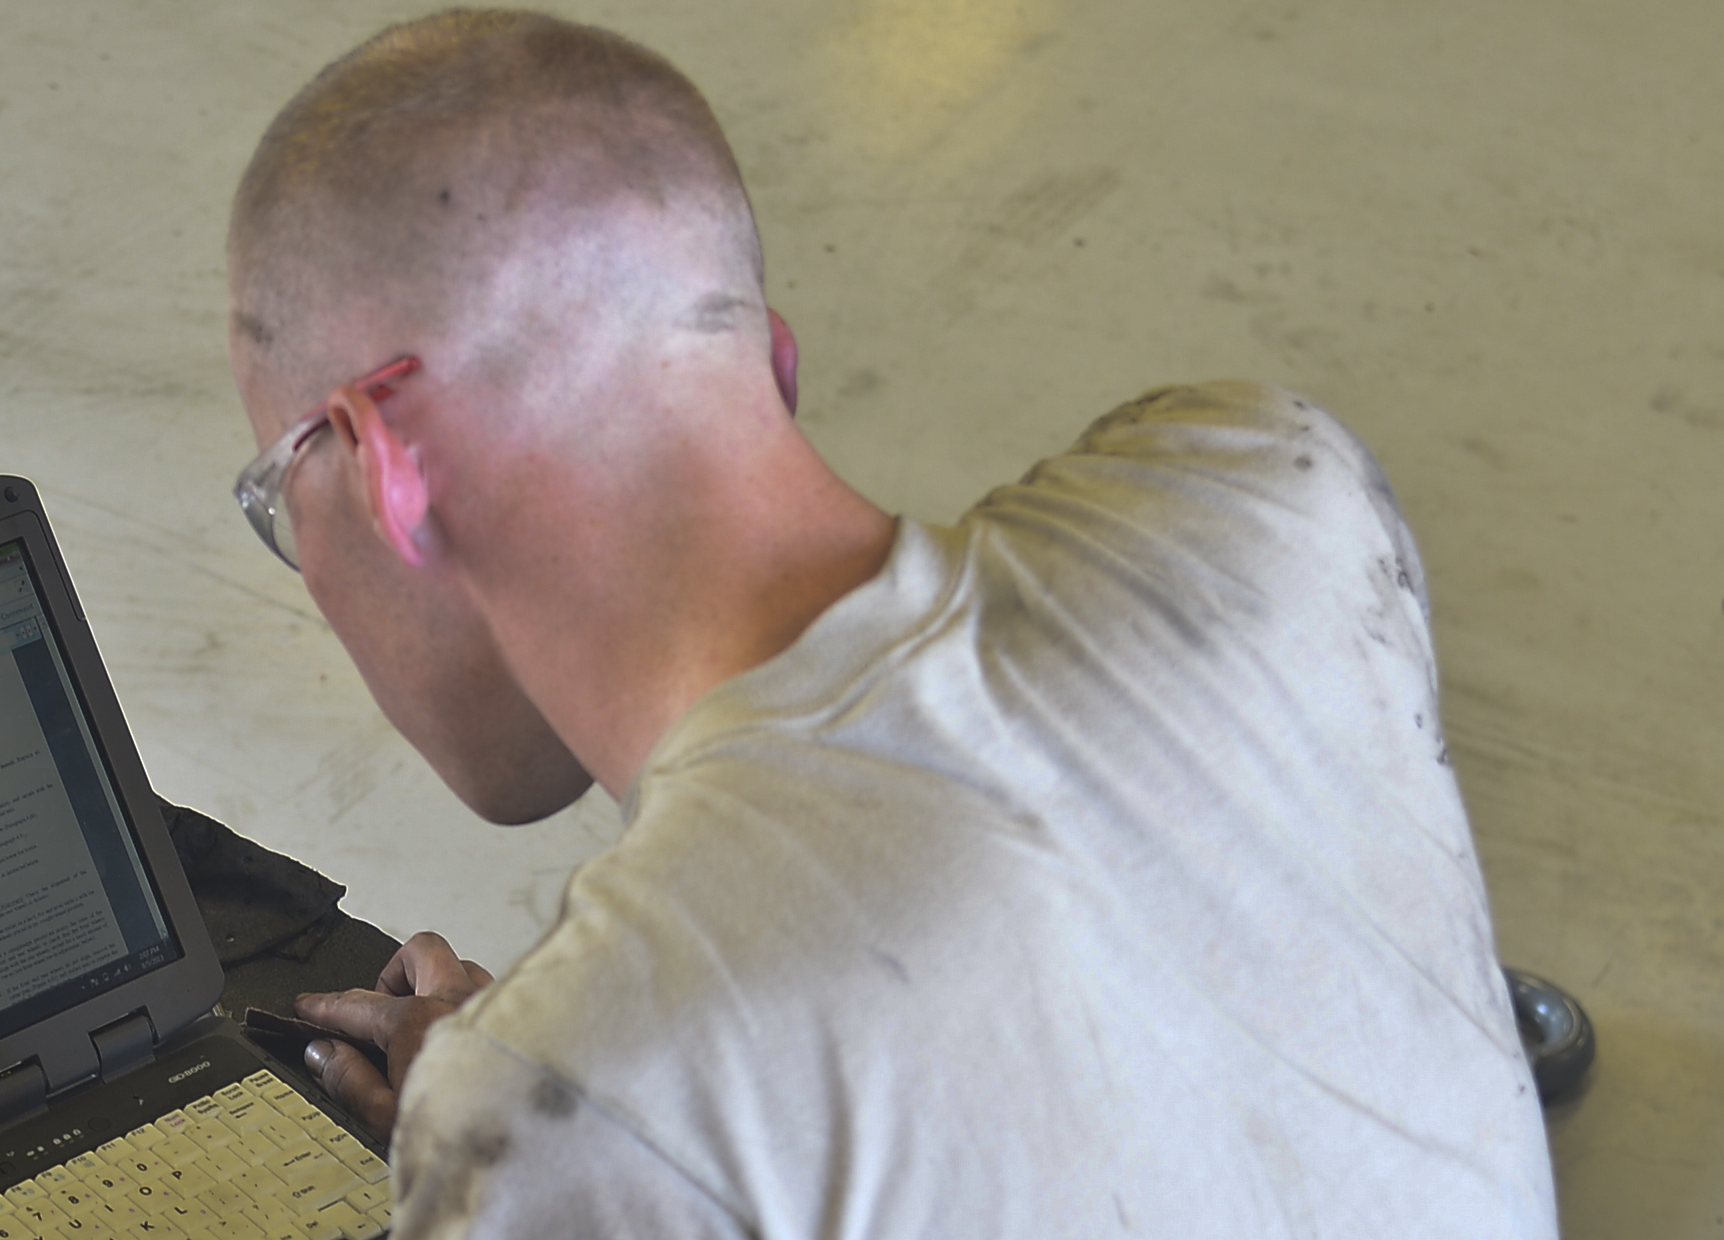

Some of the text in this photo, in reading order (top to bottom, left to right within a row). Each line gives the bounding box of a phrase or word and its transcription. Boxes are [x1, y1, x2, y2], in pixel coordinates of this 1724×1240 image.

[0, 602, 34, 621] Comment
[136, 1163, 148, 1171] 0
[172, 1171, 182, 1180] P
[102, 1179, 114, 1188] 9
[139, 1186, 152, 1196] O
[68, 1196, 79, 1204] 8
[104, 1204, 114, 1212] I
[174, 1207, 188, 1215] L
[32, 1212, 42, 1221] 7
[68, 1219, 82, 1229] U
[140, 1221, 155, 1231] K
